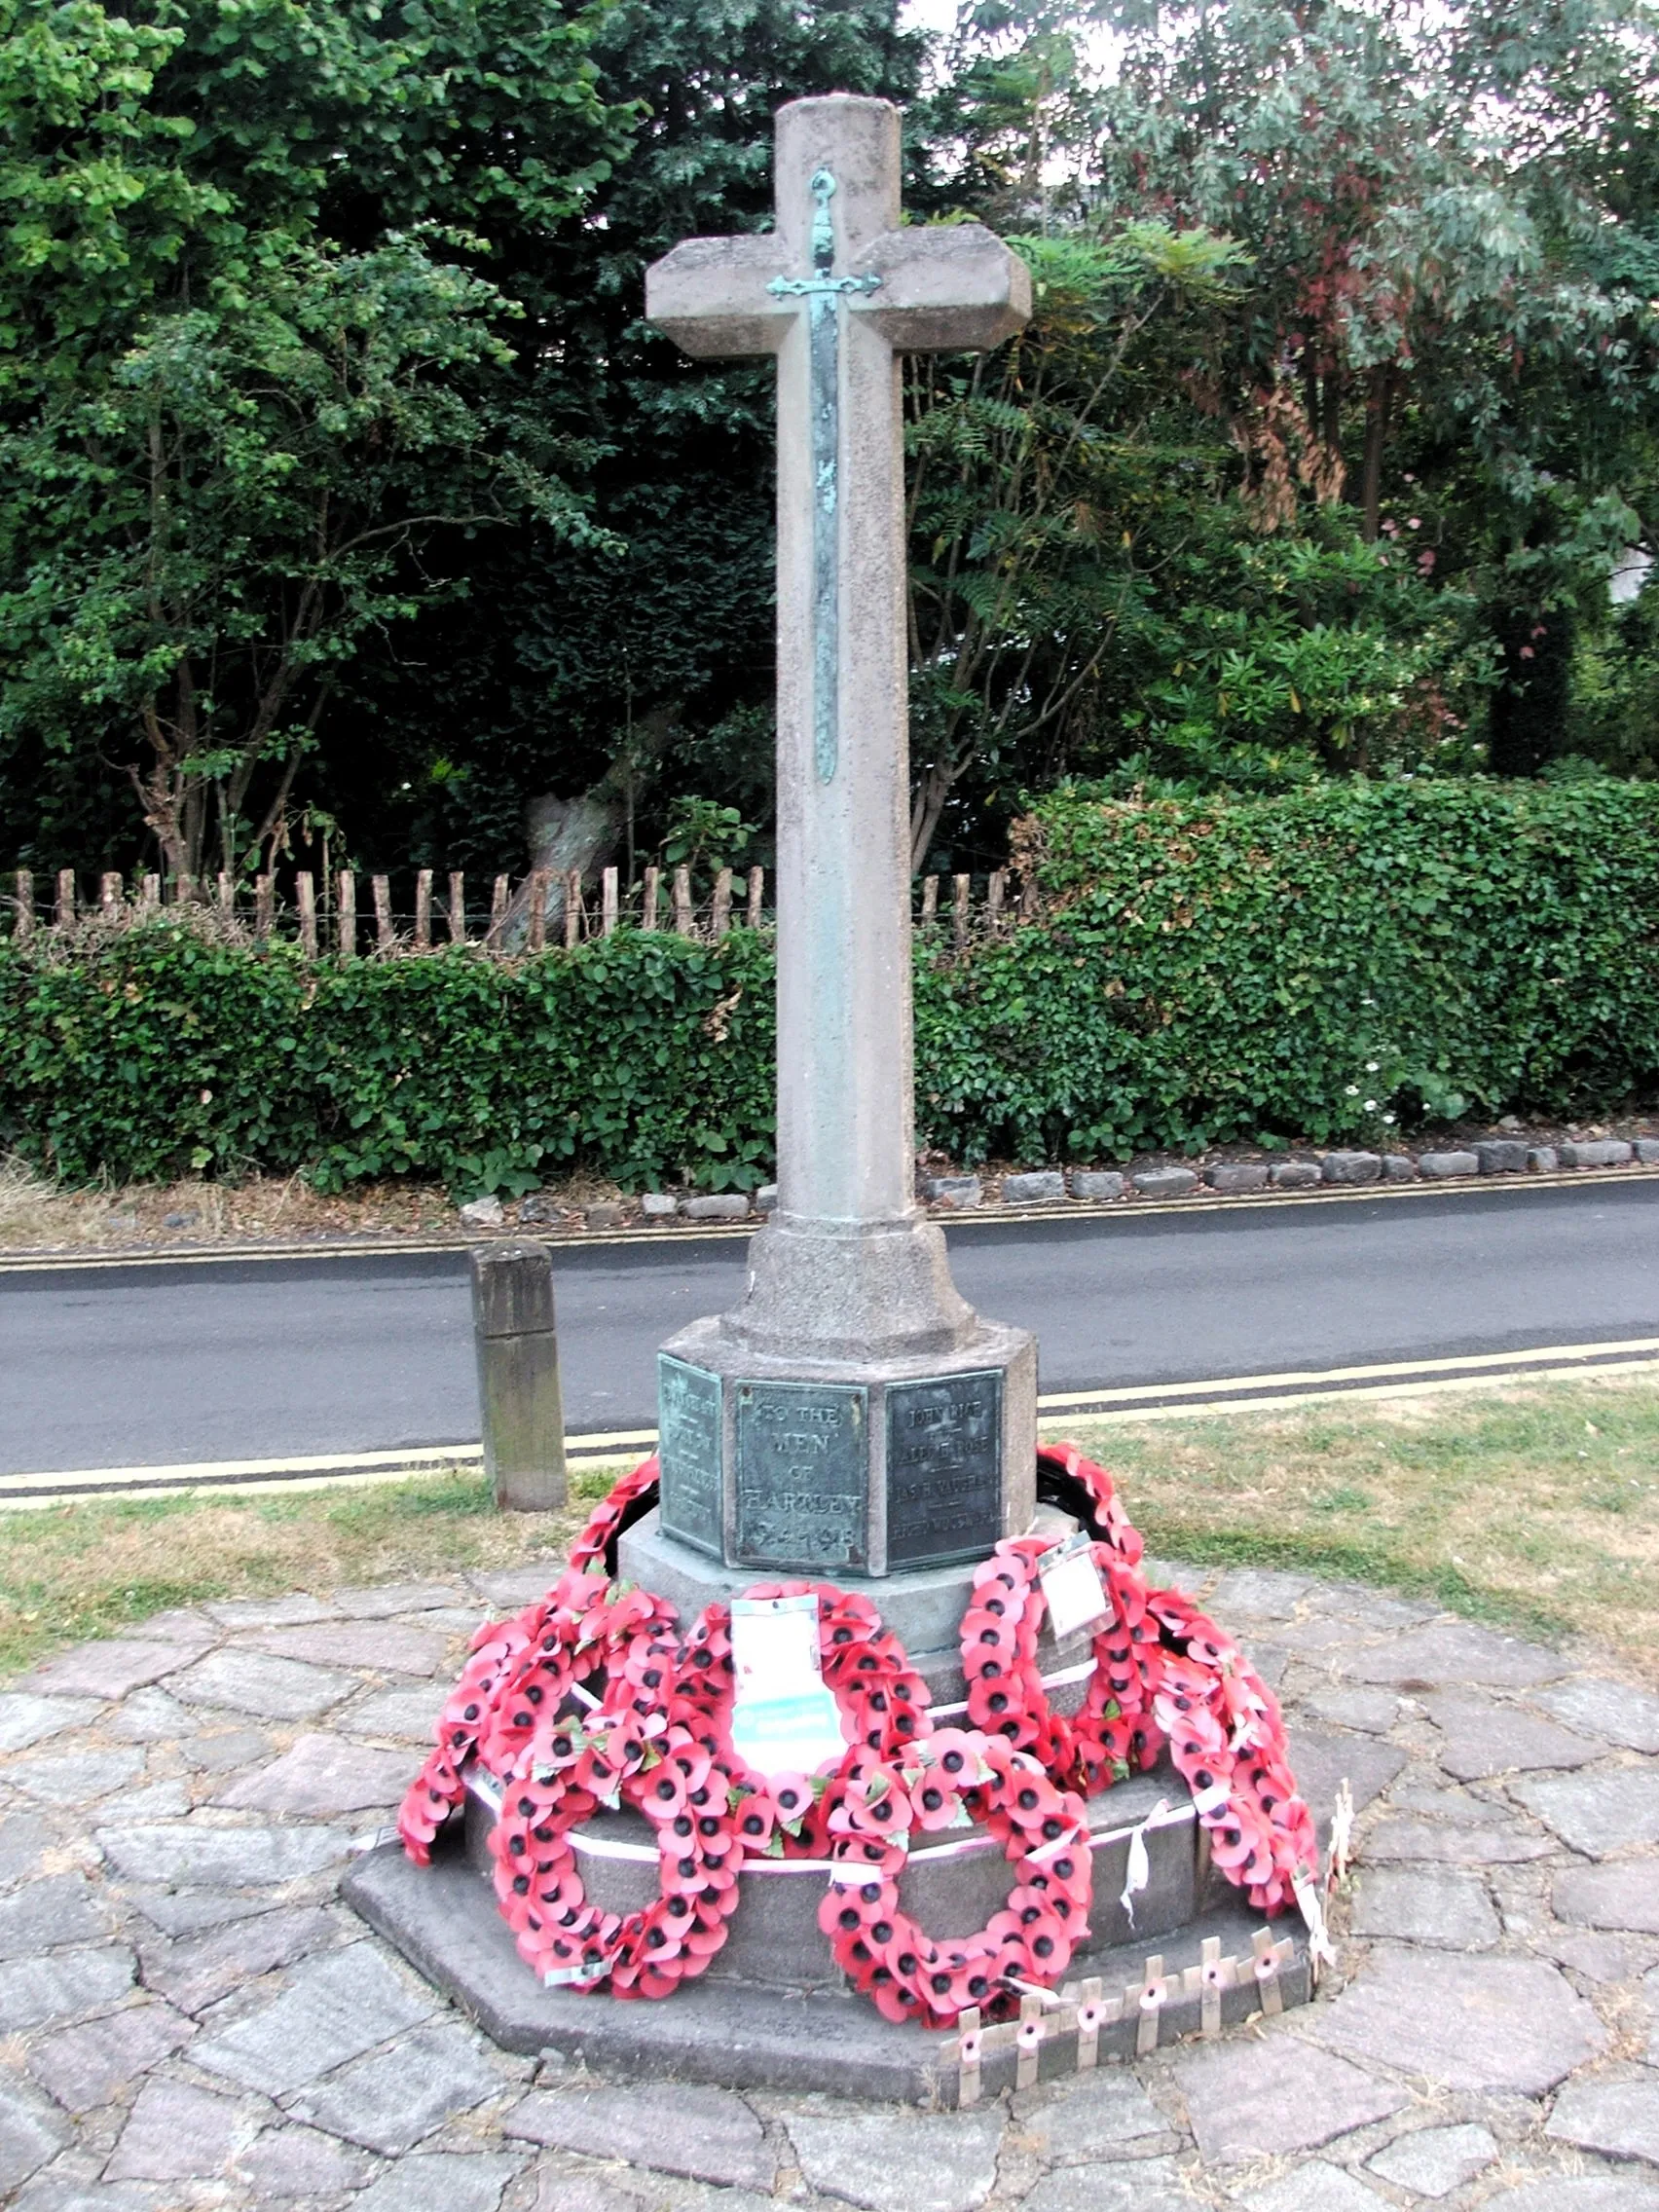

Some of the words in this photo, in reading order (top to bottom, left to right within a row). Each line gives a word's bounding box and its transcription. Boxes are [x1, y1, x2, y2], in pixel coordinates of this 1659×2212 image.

[796, 1407, 839, 1426] THE
[908, 1407, 944, 1429] JOHN
[771, 1432, 830, 1455] MEN
[789, 1465, 815, 1481] OF
[743, 1489, 863, 1516] HARTLEY
